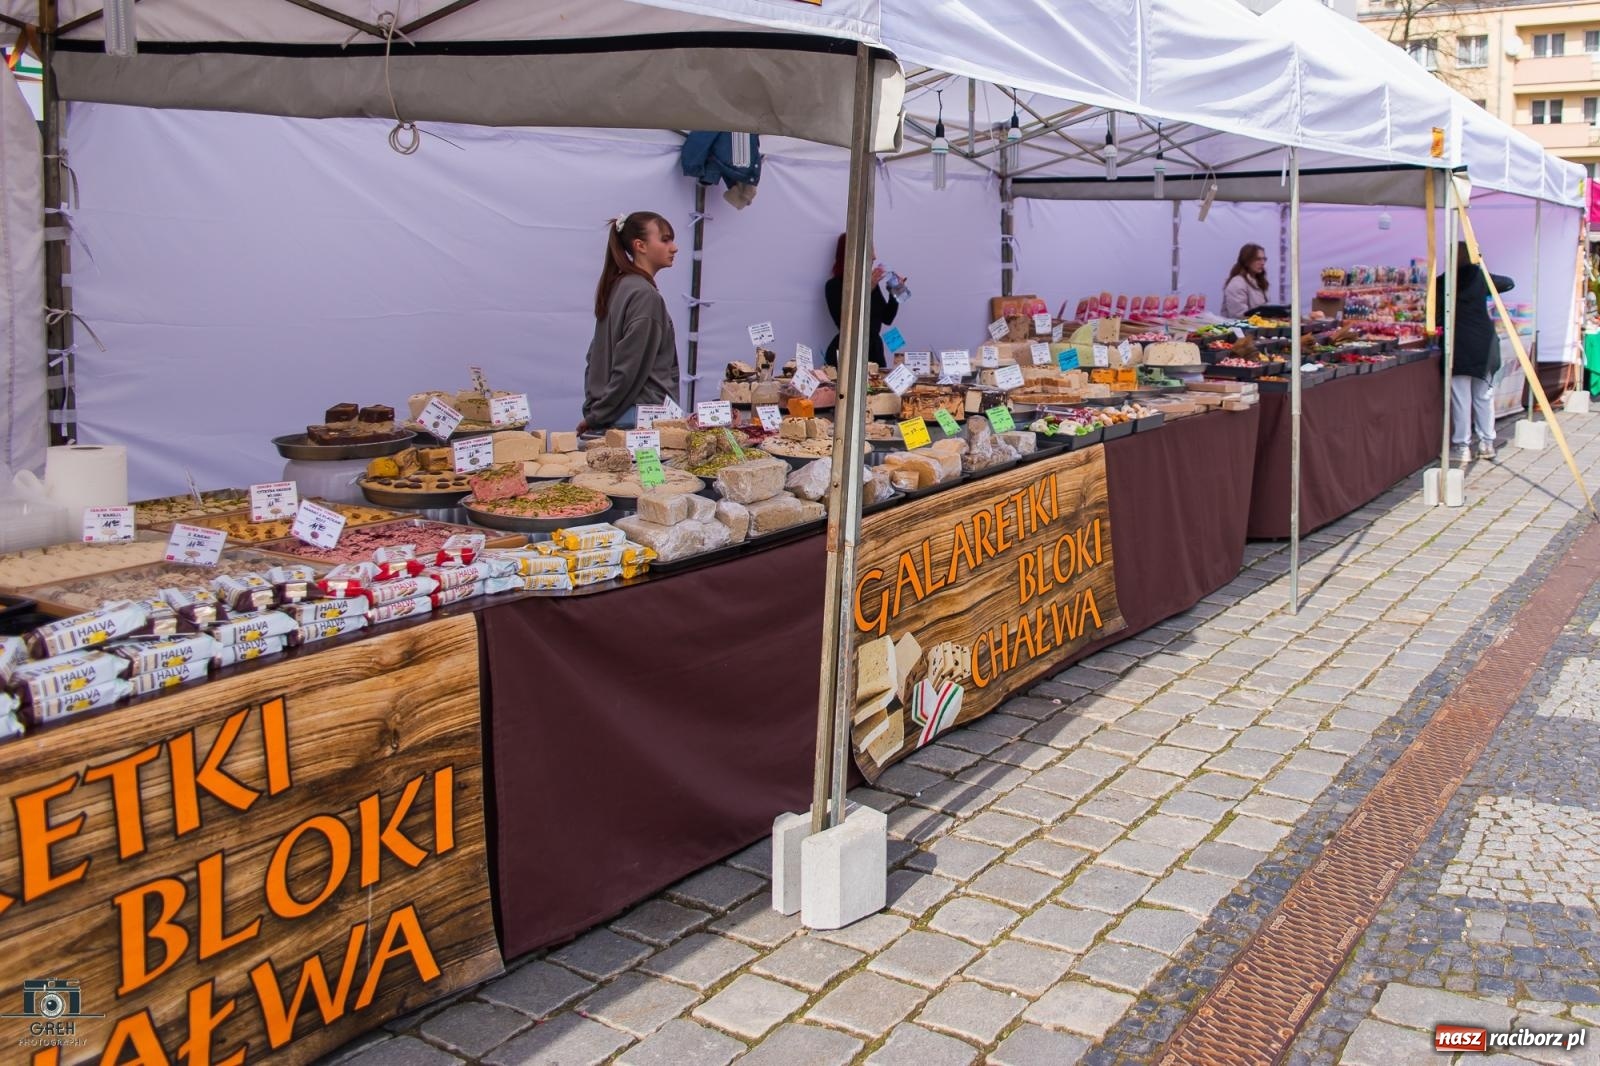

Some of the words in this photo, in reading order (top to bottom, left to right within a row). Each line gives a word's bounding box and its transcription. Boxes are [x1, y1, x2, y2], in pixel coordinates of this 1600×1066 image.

[853, 472, 1059, 637] GALARETKI
[1016, 518, 1104, 606] BLOKI
[320, 600, 348, 612] HALVA
[77, 619, 116, 637] HALVA
[239, 620, 269, 634] HALVA
[320, 618, 346, 629] HALVA
[238, 637, 268, 651] HALVA
[970, 586, 1104, 688] CHAŁWA
[160, 646, 193, 661] HALVA
[61, 666, 97, 684] HALVA
[157, 665, 190, 681] HALVA
[64, 688, 101, 705] HALVA
[0, 695, 292, 917] ETKI
[113, 765, 456, 998] BLOKI
[28, 903, 442, 1066] AŁWA
